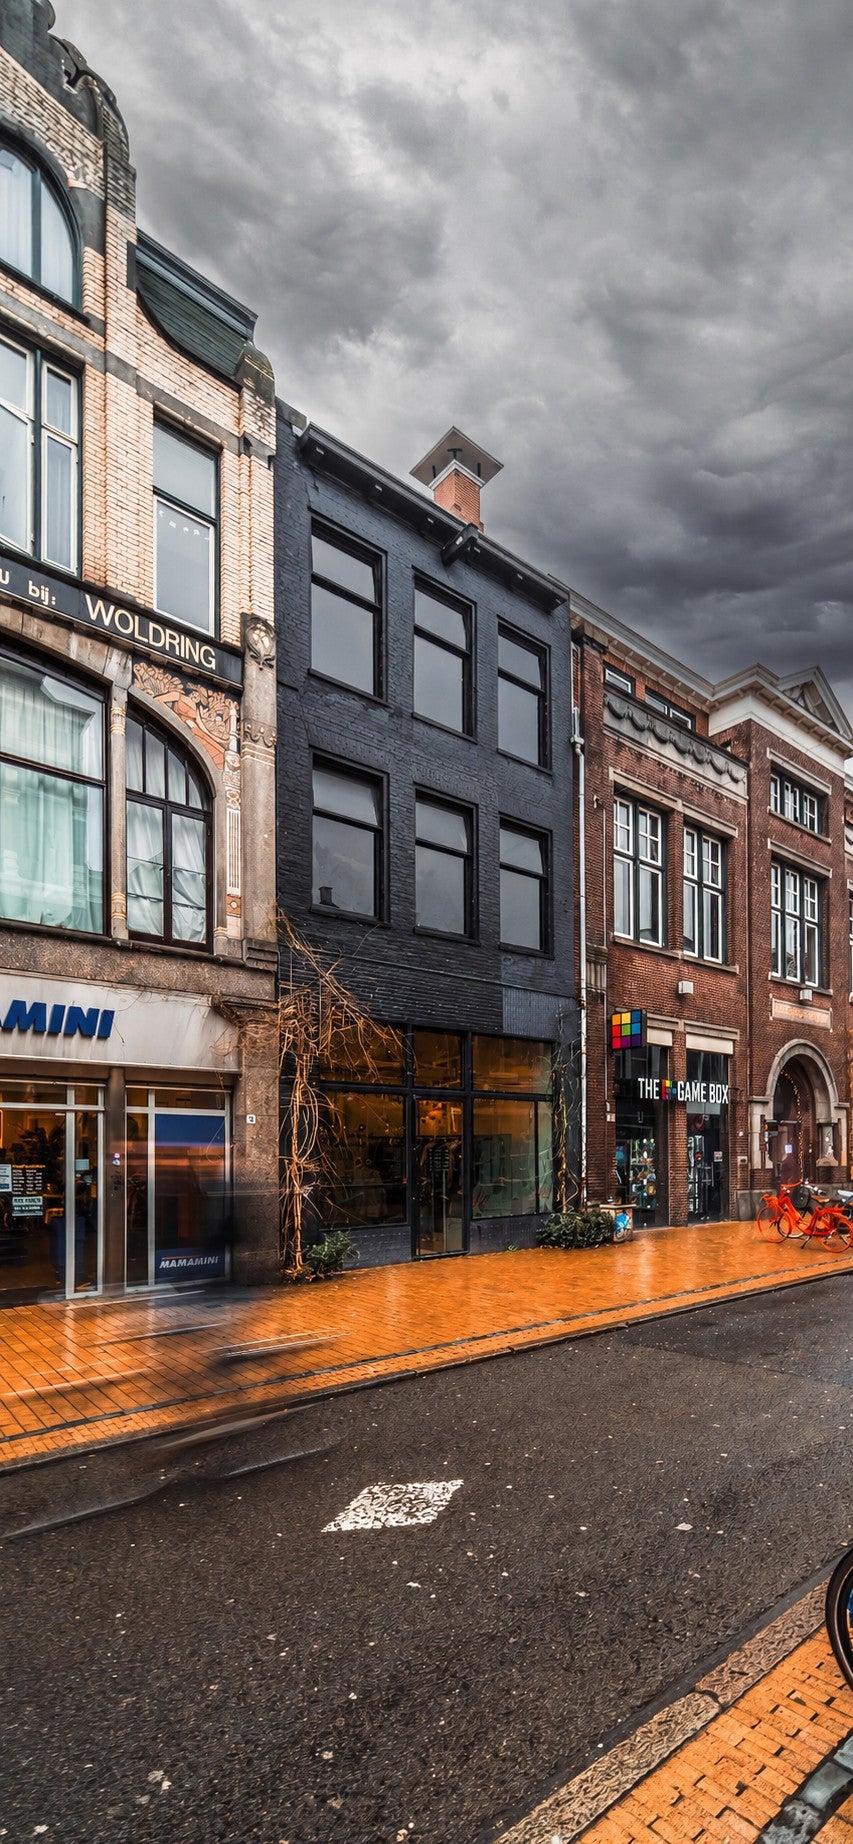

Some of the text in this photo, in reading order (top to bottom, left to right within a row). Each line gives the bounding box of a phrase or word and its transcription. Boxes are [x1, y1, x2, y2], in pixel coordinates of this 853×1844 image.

[28, 580, 56, 606] bij:
[85, 593, 216, 670] WOLDRING
[0, 999, 115, 1040] MINI
[637, 1077, 729, 1104] THE GAME BOX
[159, 1255, 219, 1269] MAMAMINI
